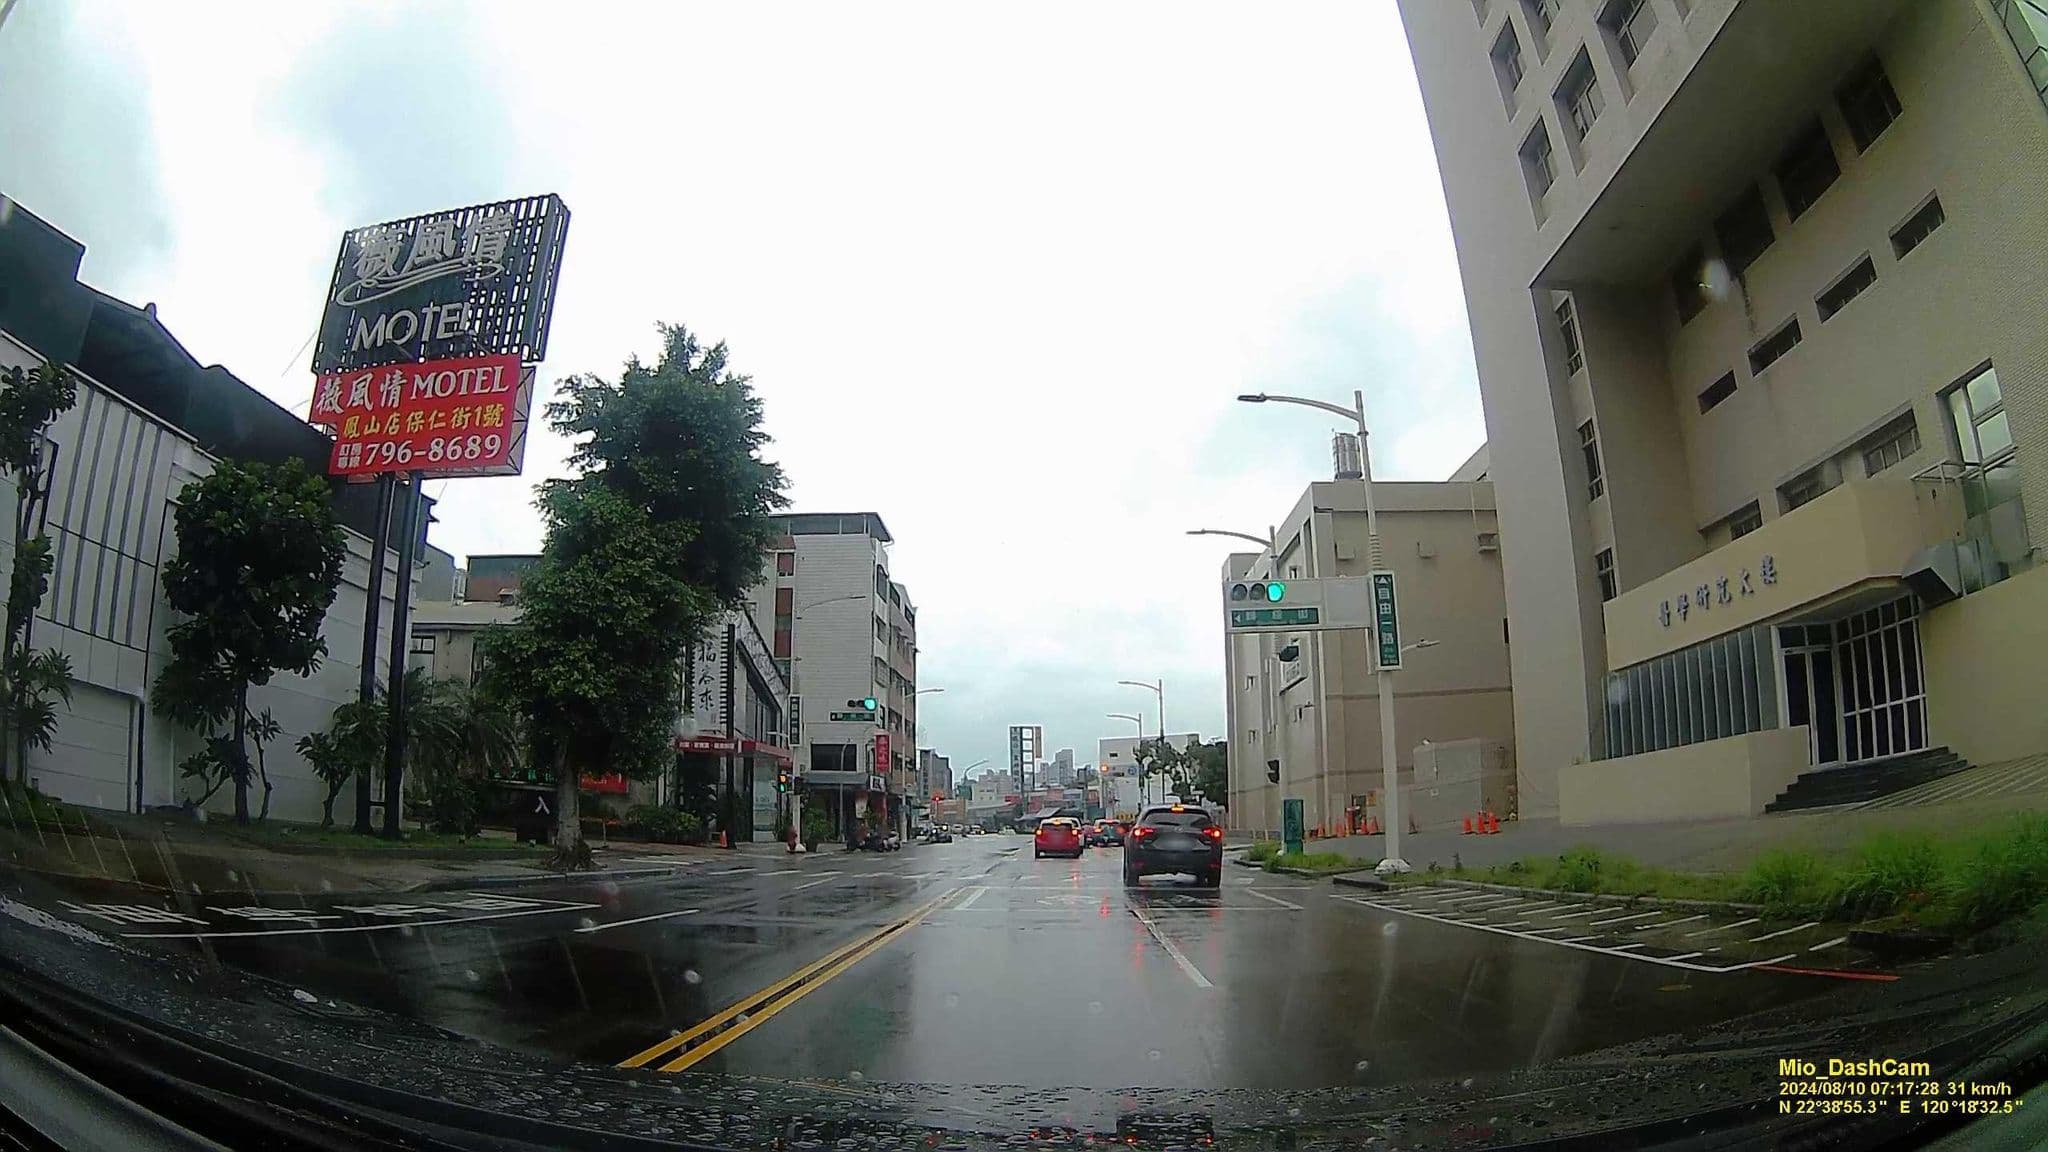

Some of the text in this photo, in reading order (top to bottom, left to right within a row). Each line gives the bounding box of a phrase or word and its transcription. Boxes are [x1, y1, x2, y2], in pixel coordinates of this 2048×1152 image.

[351, 301, 479, 352] MOTEL
[316, 364, 511, 415] 薇風情 MOTEL
[365, 434, 501, 466] 796-8689
